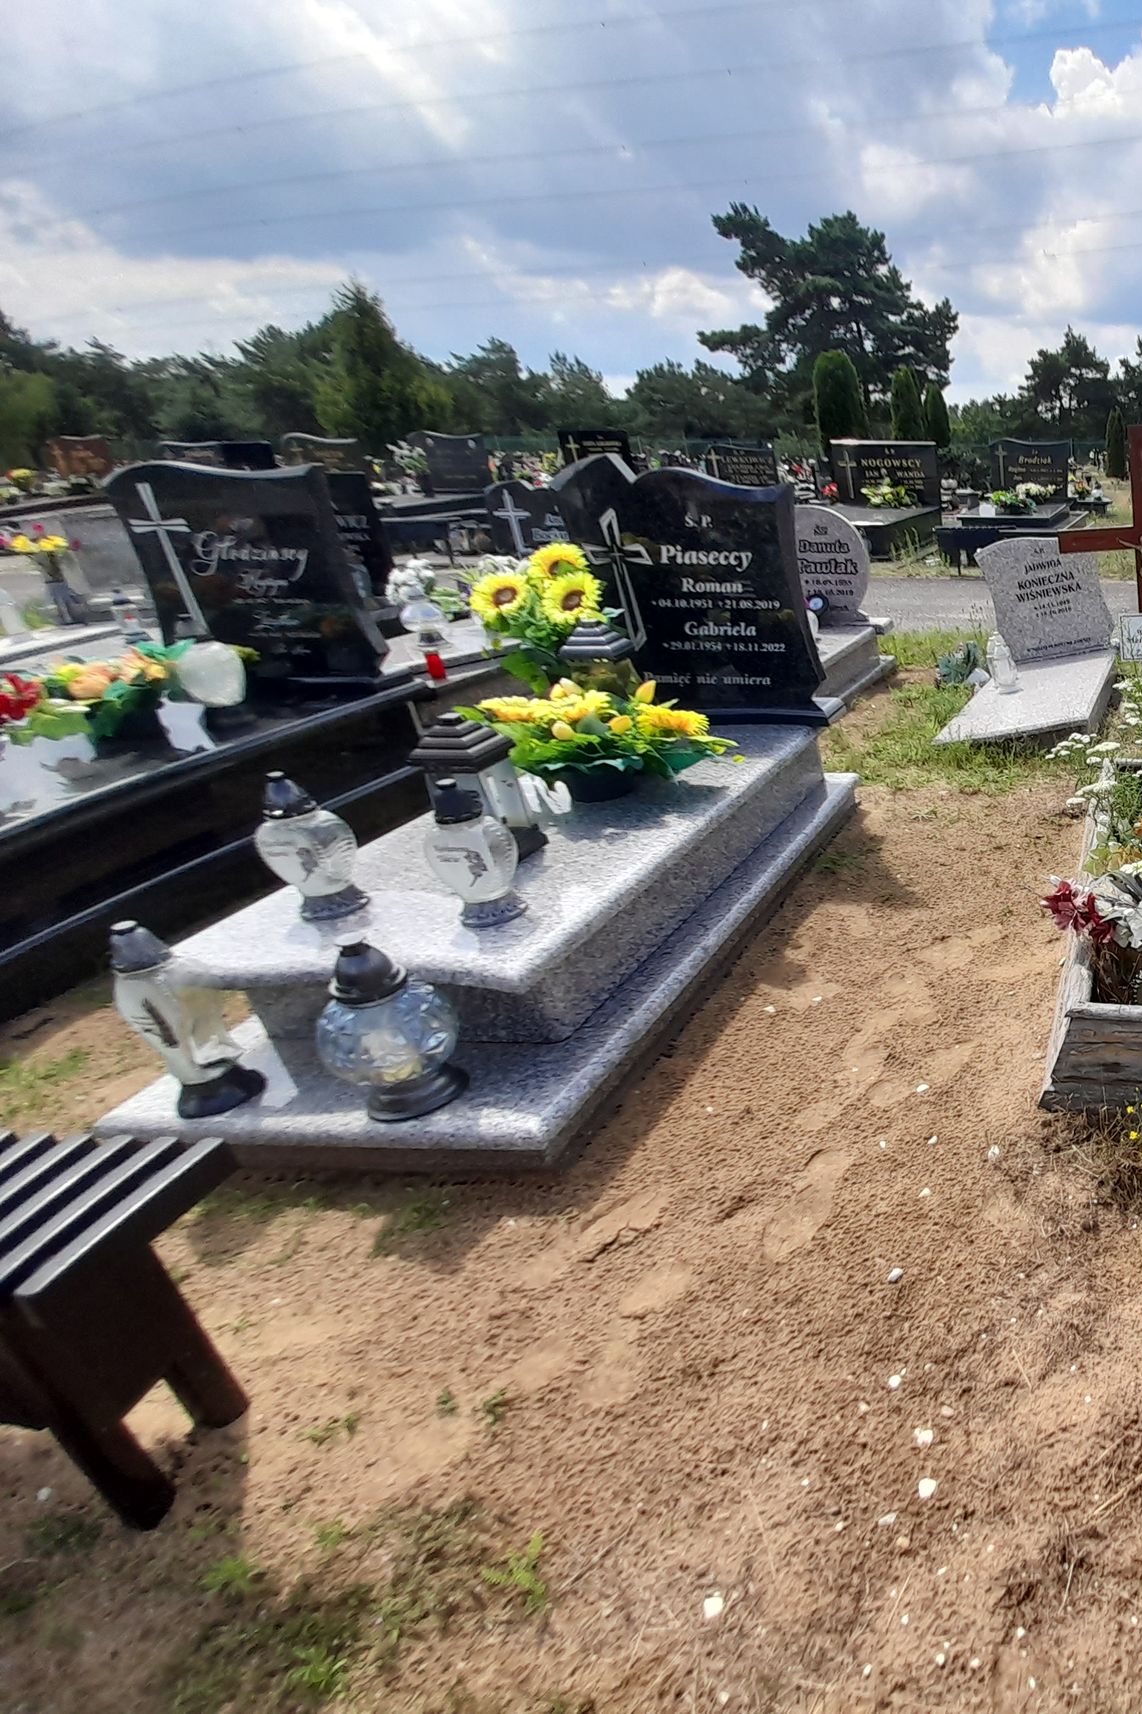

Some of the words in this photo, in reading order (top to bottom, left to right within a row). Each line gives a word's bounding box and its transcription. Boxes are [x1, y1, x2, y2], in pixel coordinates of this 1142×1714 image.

[860, 458, 921, 468] NOGOWSCY
[799, 540, 850, 554] Danuta
[659, 544, 753, 572] Piaseccy
[797, 558, 859, 575] Pawlak
[681, 577, 744, 593] Roman
[1017, 570, 1075, 591] KONIECZNA
[1016, 582, 1082, 603] WIŚNIEWSKA
[684, 621, 757, 636] Gabriela
[696, 673, 718, 684] nie
